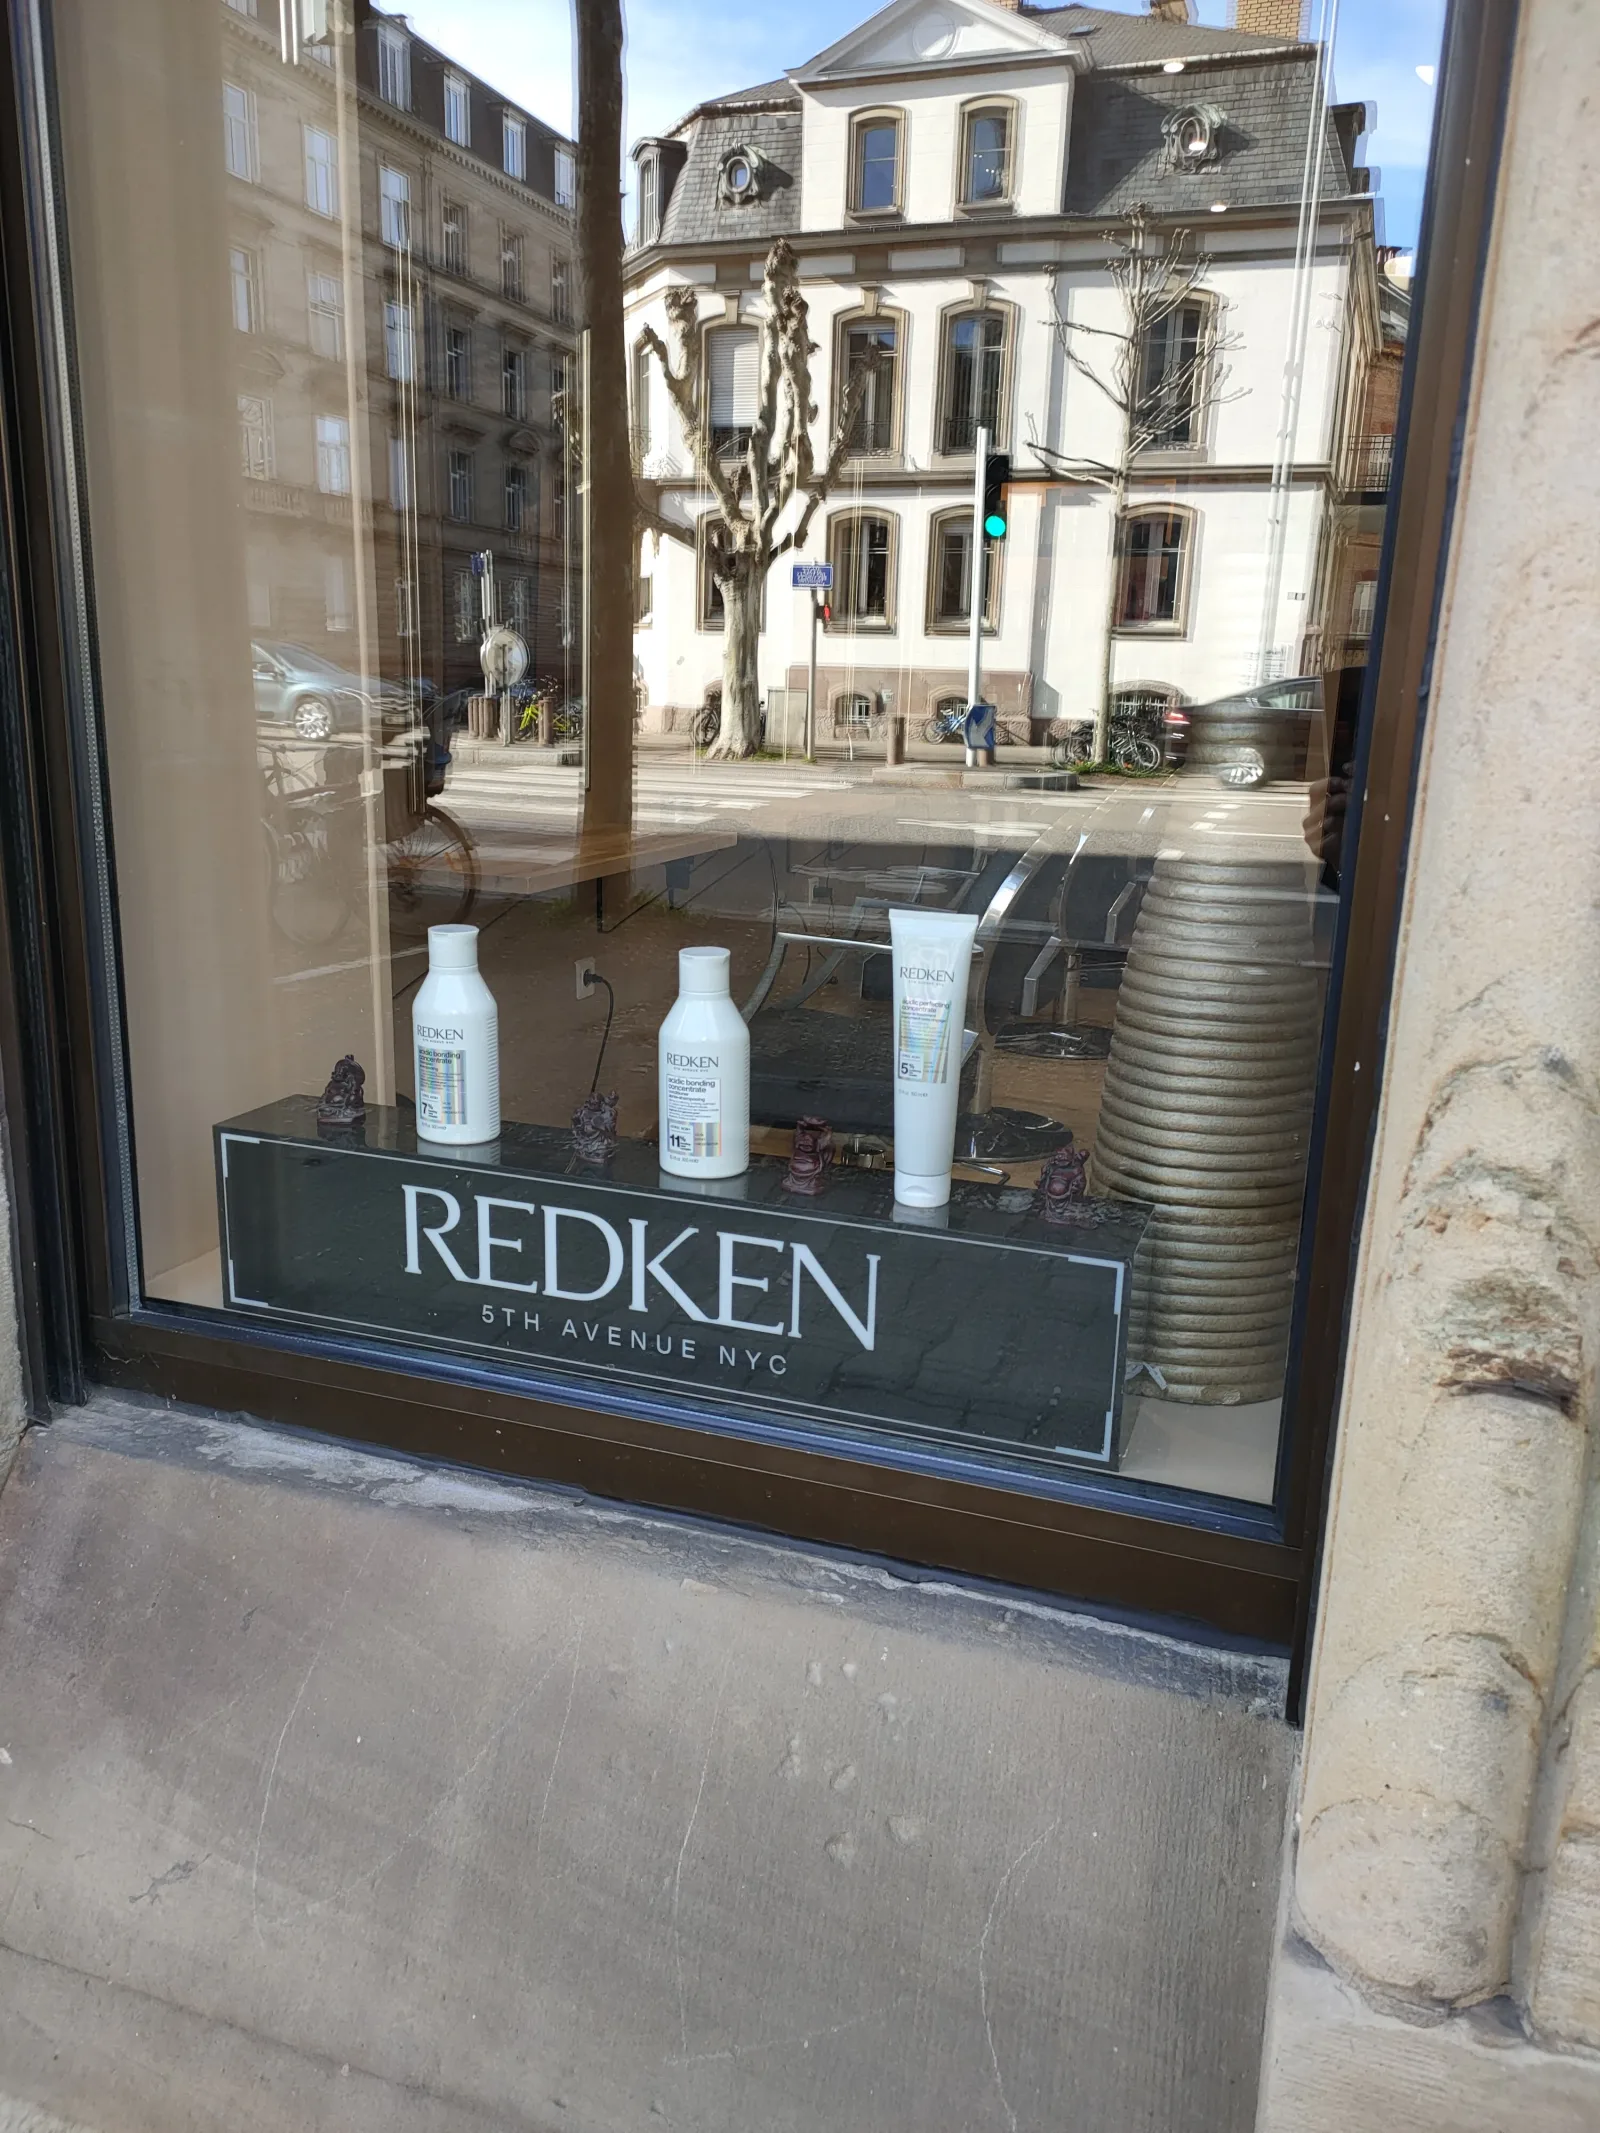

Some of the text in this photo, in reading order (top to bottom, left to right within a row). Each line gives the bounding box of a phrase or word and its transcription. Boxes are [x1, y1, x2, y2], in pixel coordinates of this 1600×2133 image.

[900, 966, 955, 983] REDKEN
[417, 1024, 464, 1040] REDKEN
[419, 1055, 452, 1065] concentrate
[433, 1051, 461, 1060] bonding
[666, 1052, 719, 1068] REDKEN
[668, 1077, 715, 1088] acidic bonding
[668, 1083, 707, 1093] concentrate
[401, 1184, 881, 1352] REDKEN
[481, 1304, 788, 1375] 5TH AVENUE NYC
